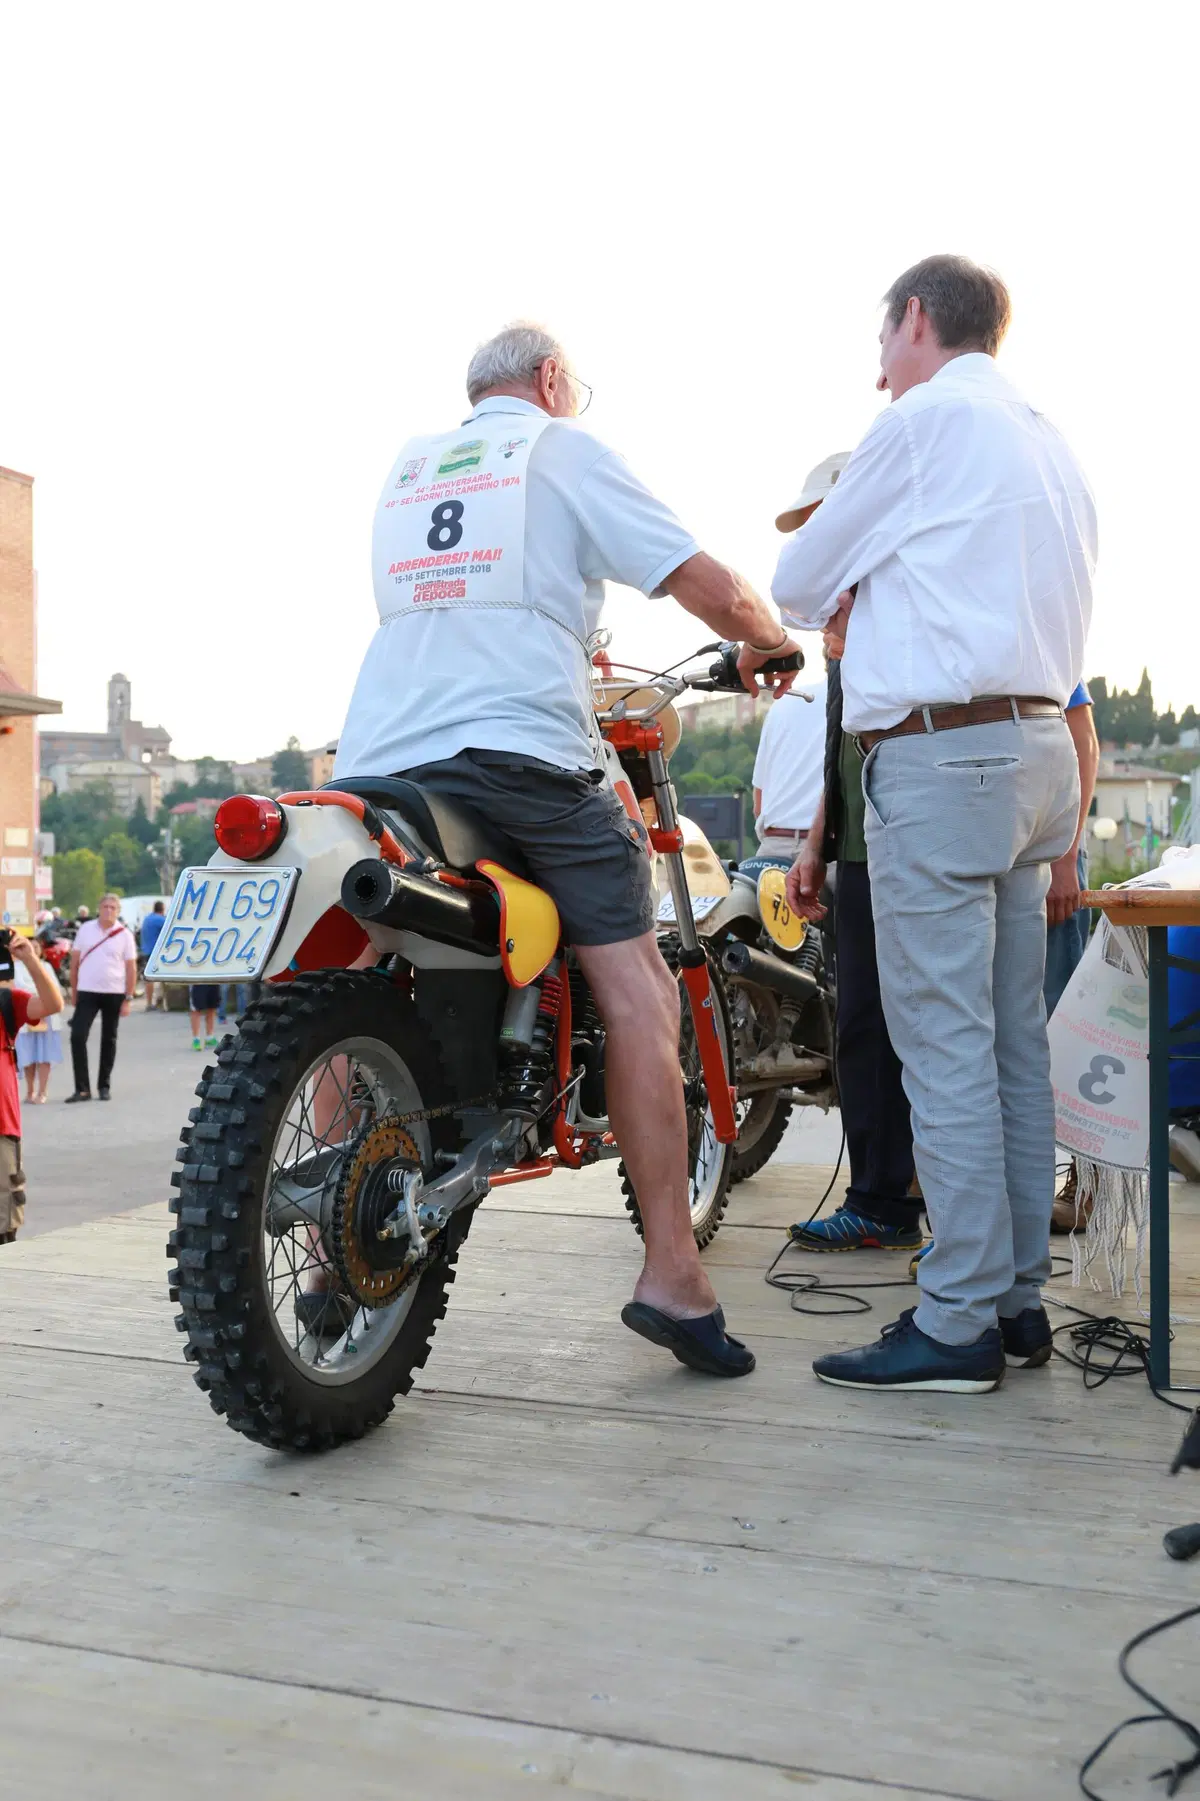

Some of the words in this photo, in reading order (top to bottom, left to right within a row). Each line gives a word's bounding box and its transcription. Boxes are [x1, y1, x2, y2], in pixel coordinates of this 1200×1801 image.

[400, 497, 413, 506] SEI
[415, 491, 443, 503] GIORNI
[445, 488, 454, 497] DI
[455, 481, 499, 495] CAMERINO
[501, 476, 521, 487] 1974
[430, 472, 493, 491] ANNIVERSARIO
[427, 500, 464, 551] 8
[388, 551, 470, 575] ARRENDERSI?
[471, 548, 503, 562] MAI!
[395, 573, 414, 585] 15-16
[415, 565, 467, 580] SETTEMBRE
[469, 564, 492, 574] 2018
[176, 879, 226, 921] MI
[230, 879, 281, 920] 69
[159, 925, 263, 967] 5504
